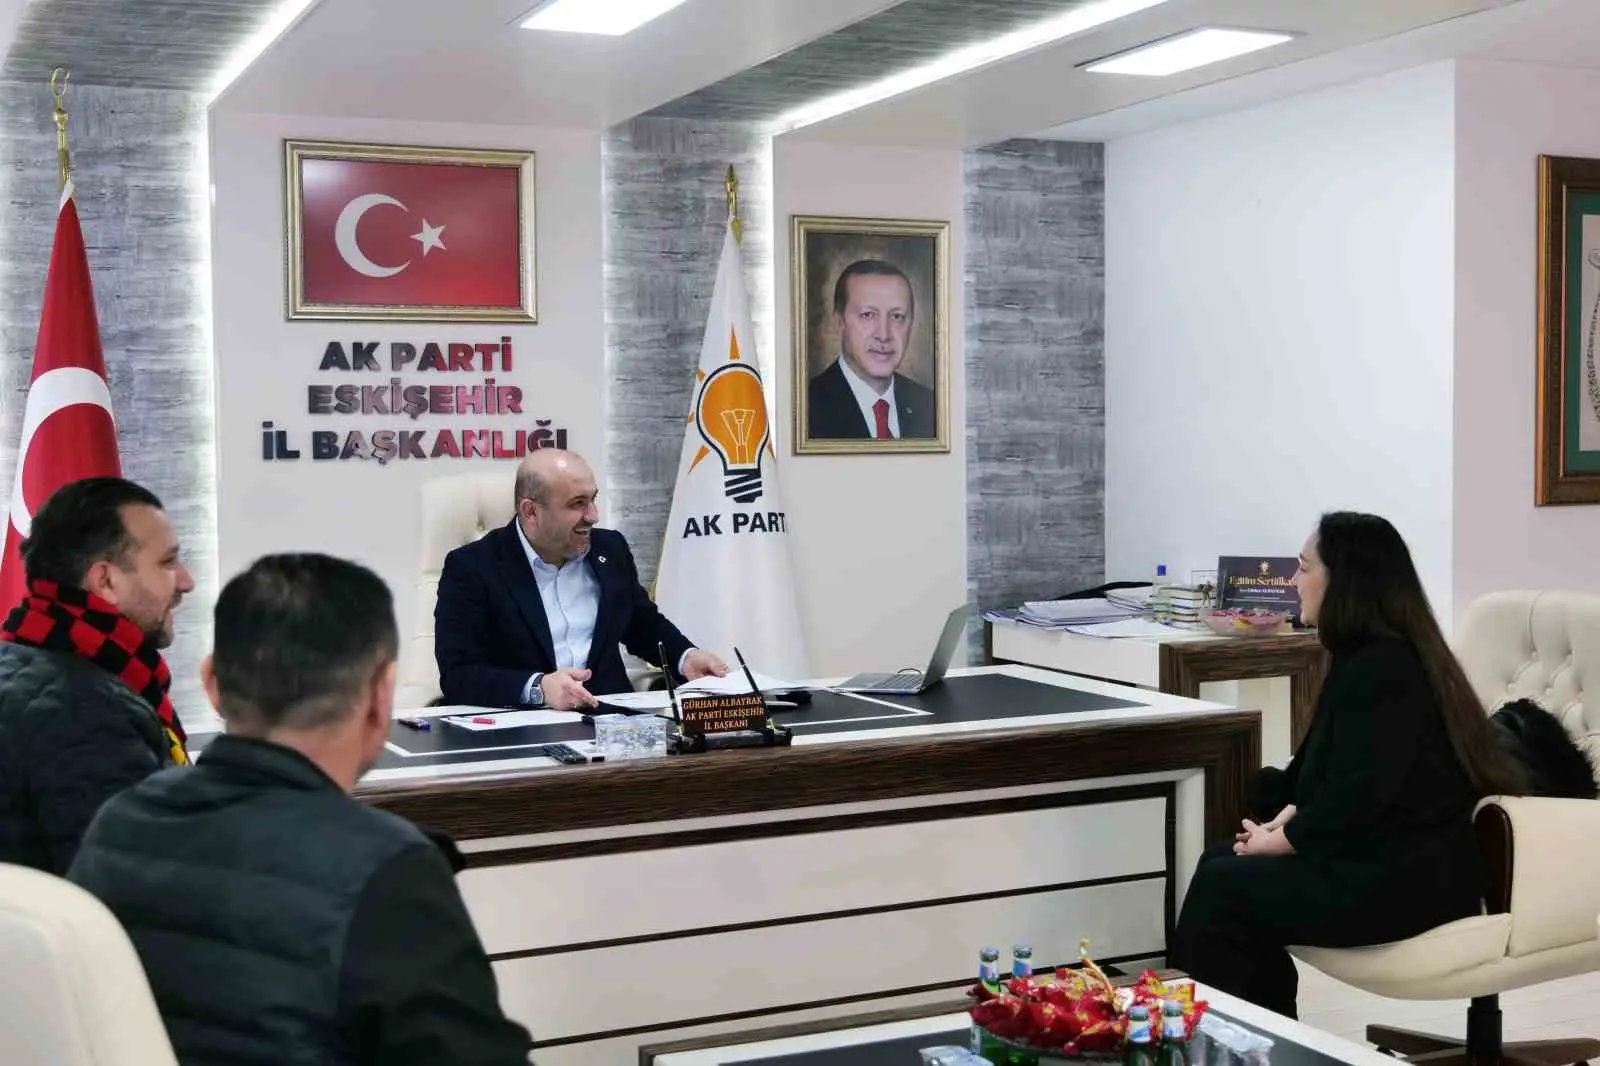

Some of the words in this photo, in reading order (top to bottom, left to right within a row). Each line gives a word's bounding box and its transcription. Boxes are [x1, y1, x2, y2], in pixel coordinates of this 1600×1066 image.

[319, 341, 381, 371] AK
[390, 336, 513, 372] PARTİ
[308, 378, 523, 420] ESKİŞEHİR
[262, 420, 300, 460] İL
[312, 419, 568, 465] BAŞKANLIĞI
[682, 514, 723, 539] AK
[732, 511, 786, 534] PART
[683, 700, 718, 709] GÜRHAN
[685, 711, 697, 721] AK
[698, 710, 722, 719] PARTİ
